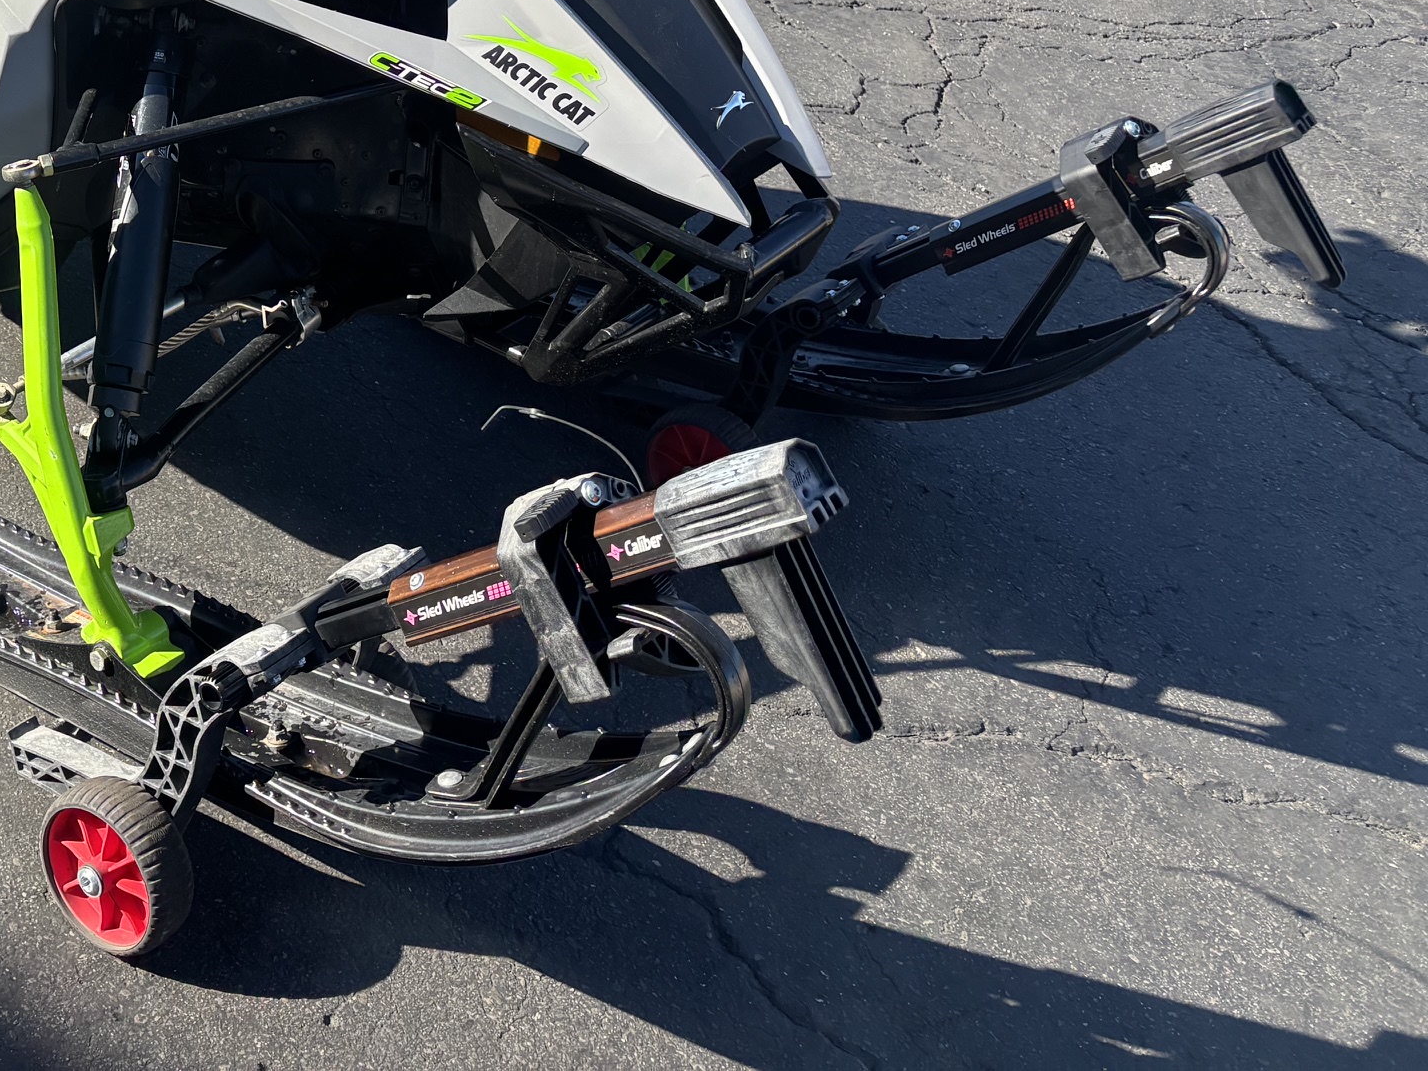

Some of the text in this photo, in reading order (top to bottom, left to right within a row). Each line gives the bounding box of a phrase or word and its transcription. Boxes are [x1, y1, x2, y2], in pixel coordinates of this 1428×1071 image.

[481, 44, 597, 126] ARCTIC CAT
[1139, 158, 1174, 180] Caliber
[954, 222, 1016, 255] Sled Wheels
[623, 532, 664, 557] Caliber
[416, 588, 486, 622] Sled Wheels
